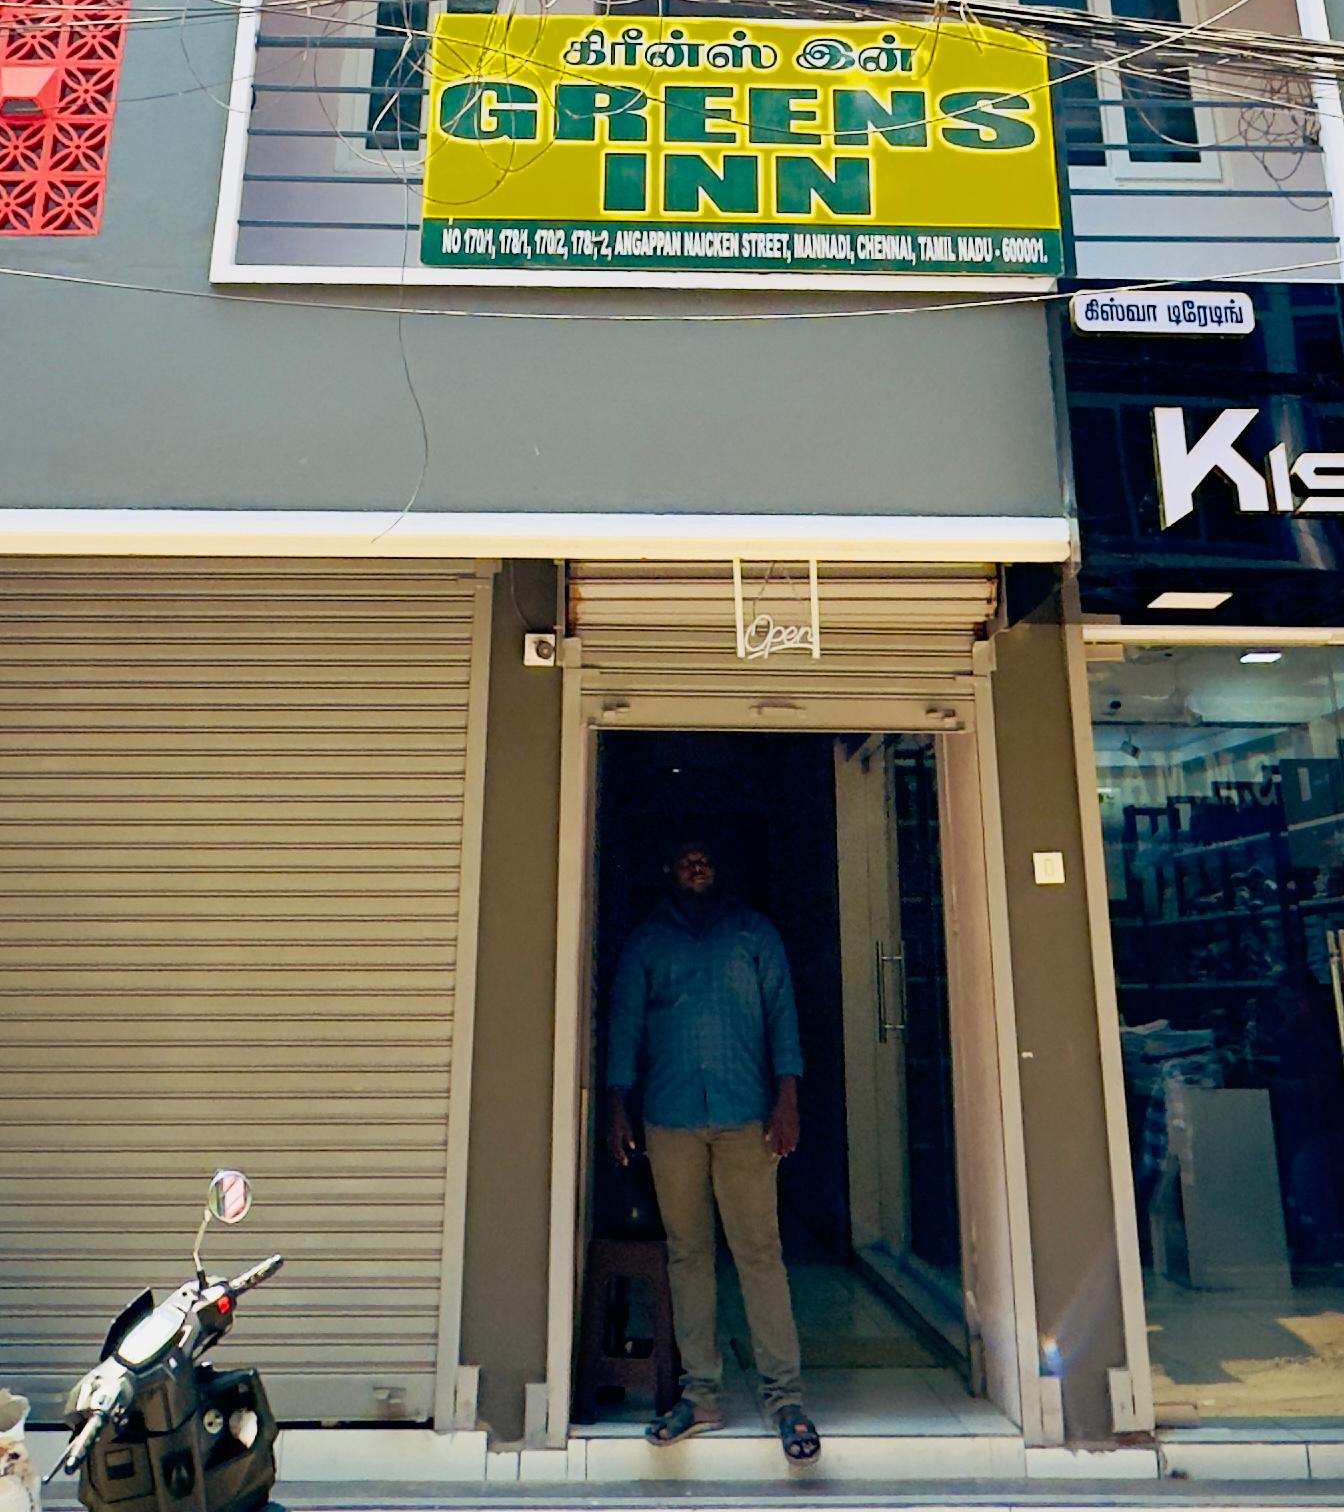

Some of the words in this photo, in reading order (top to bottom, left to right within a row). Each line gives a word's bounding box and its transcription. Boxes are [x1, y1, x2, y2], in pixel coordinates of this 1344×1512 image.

[563, 28, 778, 69] கிரீன்ஸ்
[796, 34, 918, 72] இன்
[439, 81, 1036, 150] GREENS
[603, 153, 872, 216] INN
[442, 228, 462, 254] NO
[614, 231, 681, 257] ANGAPPAN
[684, 232, 740, 258] NAICKEN
[741, 233, 792, 264] STREET,
[794, 234, 855, 264] MANNADI,
[857, 235, 916, 265] CHENNAI,
[918, 236, 956, 262] TAMIL
[958, 237, 993, 263] NADU
[1085, 297, 1157, 322] கிஸ்வா
[1167, 298, 1244, 327] டிரேடிங்
[745, 614, 816, 659] Open
